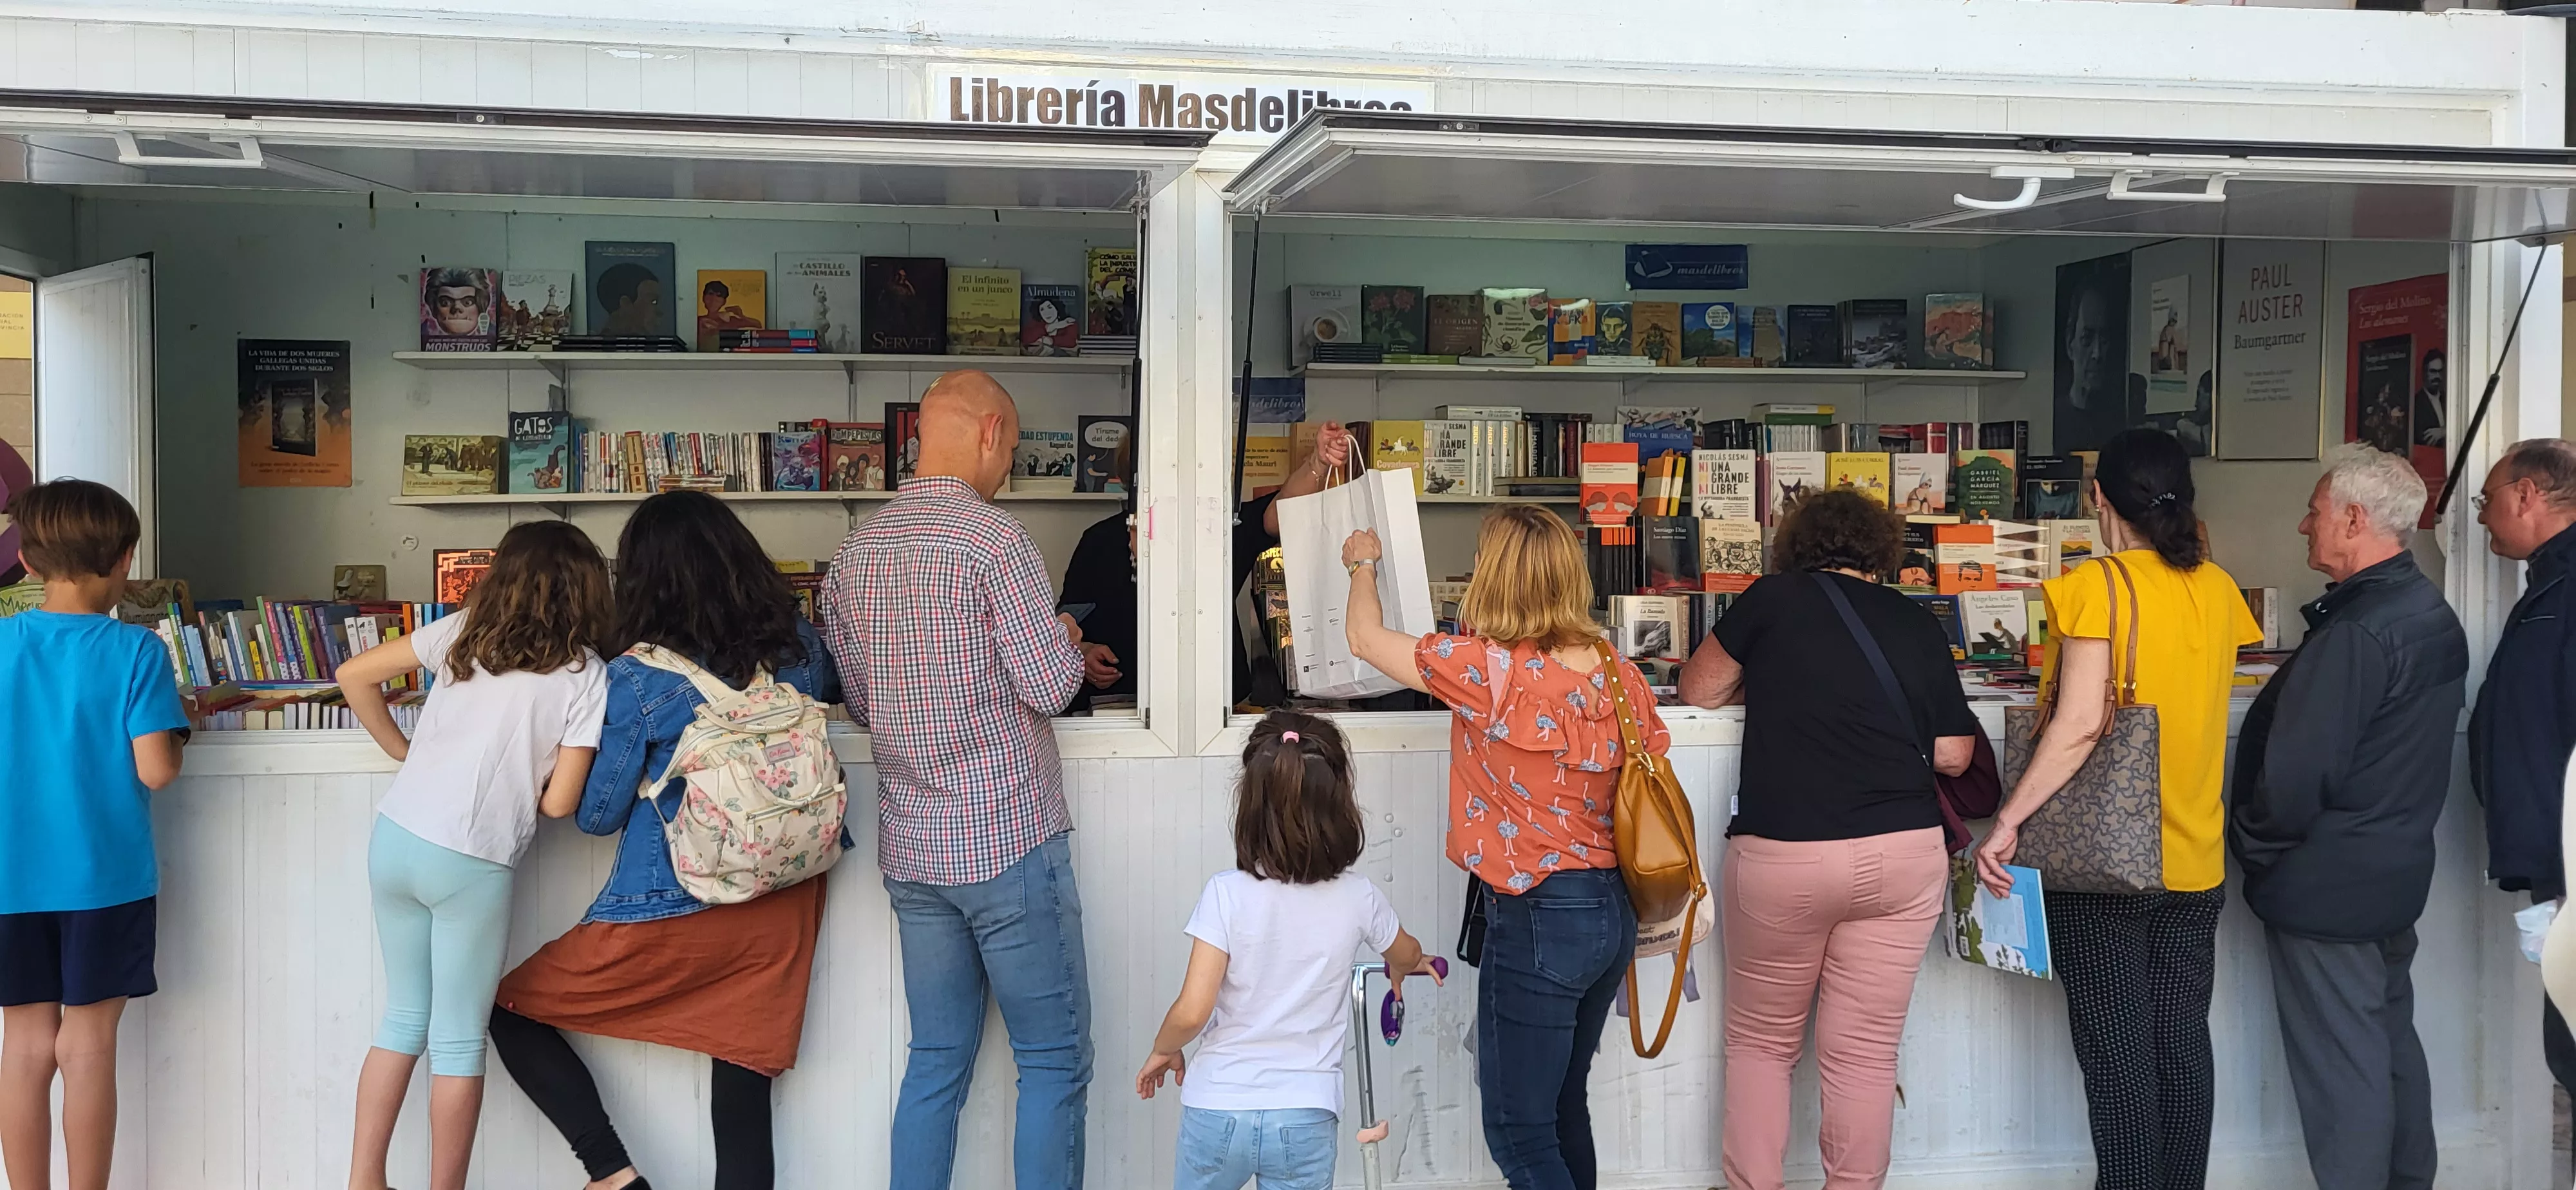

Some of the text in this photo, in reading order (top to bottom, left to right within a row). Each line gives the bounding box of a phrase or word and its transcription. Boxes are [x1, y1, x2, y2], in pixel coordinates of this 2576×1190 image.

[950, 77, 1412, 133] Librería Masdeli
[1677, 264, 1743, 275] masdelibros
[961, 275, 1010, 285] El infinito
[2251, 263, 2292, 290] PAUL
[987, 285, 1013, 294] junco
[1027, 287, 1075, 297] Almudena
[2385, 298, 2398, 310] del
[2400, 296, 2432, 308] Molino
[2238, 294, 2303, 324] AUSTER
[872, 332, 936, 350] SERVET
[2233, 332, 2306, 350] Baumgartner
[425, 343, 491, 352] MONSTRUOS
[515, 417, 553, 435] GATOS
[831, 428, 882, 442] ROMPEPISTAS
[1036, 431, 1074, 442] ESTUPENDA
[1439, 440, 1466, 449] RANDE
[1698, 453, 1726, 461] NICOLÁS
[1698, 462, 1730, 473] NI UNA
[1711, 473, 1750, 484] GRANDE
[1711, 484, 1738, 495] LIBRE
[1971, 594, 1999, 603] Ángeles
